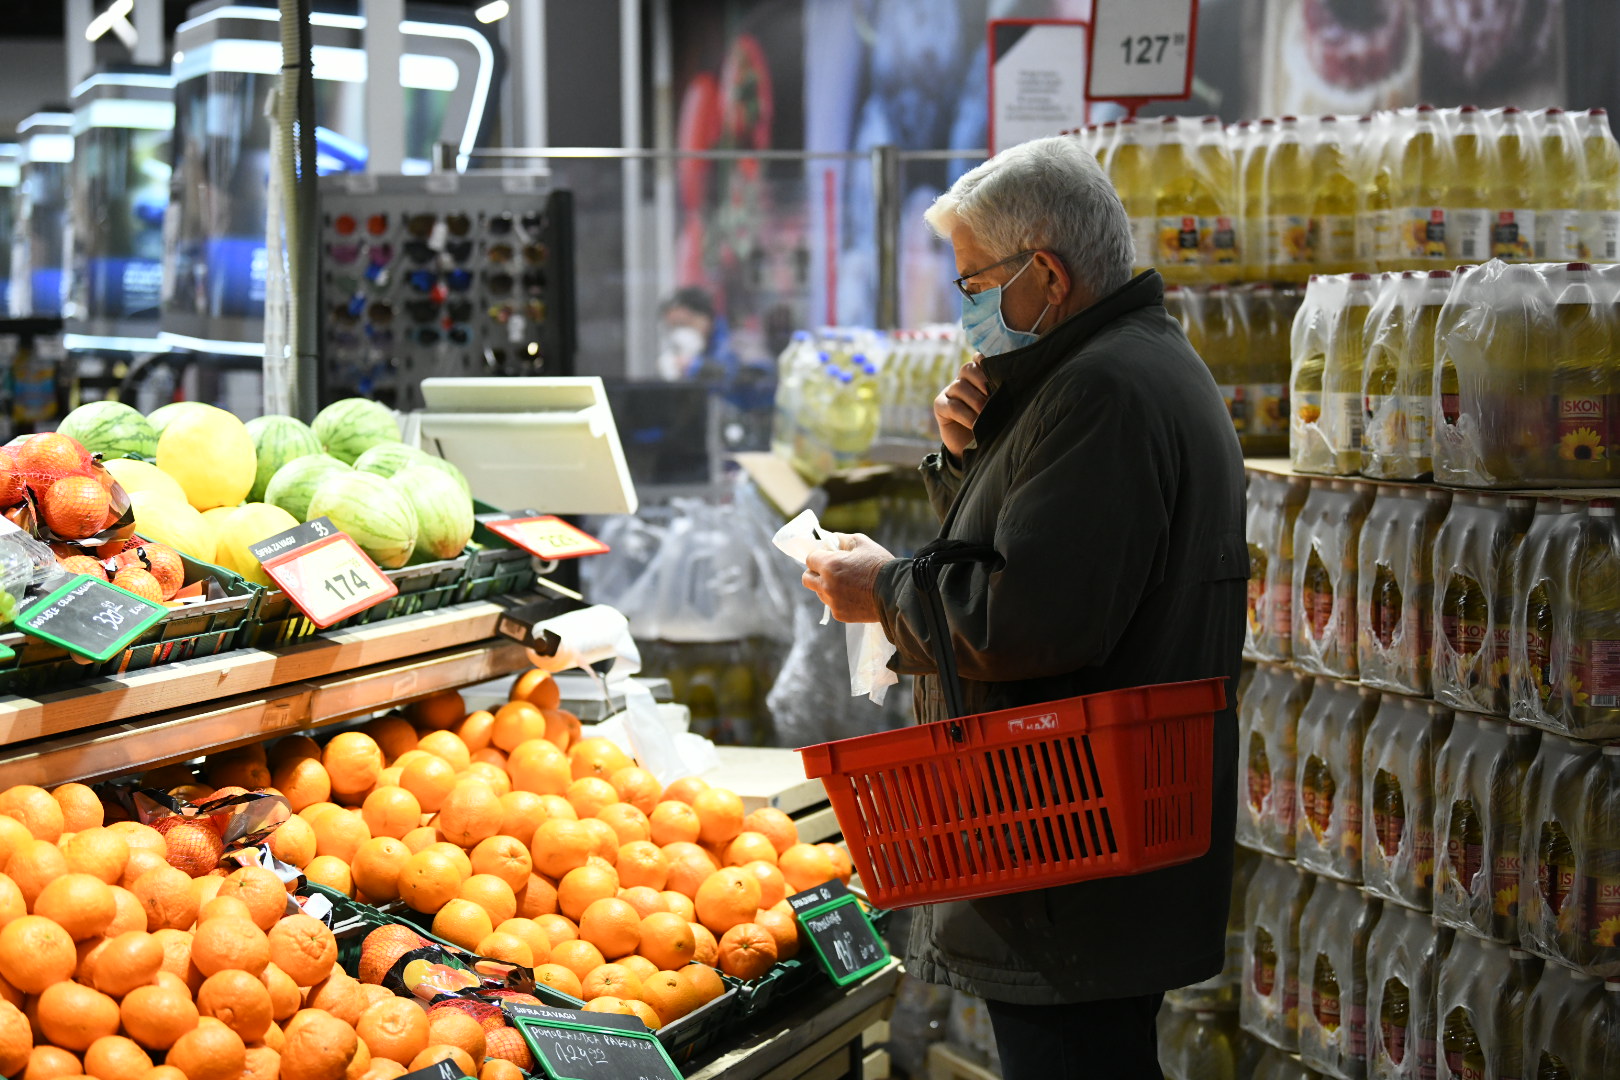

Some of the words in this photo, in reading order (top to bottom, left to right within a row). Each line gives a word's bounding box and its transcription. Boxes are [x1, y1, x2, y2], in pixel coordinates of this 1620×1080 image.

[1120, 35, 1169, 65] 127
[1561, 399, 1602, 412] ISKON
[324, 569, 370, 600] 174
[551, 1011, 577, 1020] VAGU
